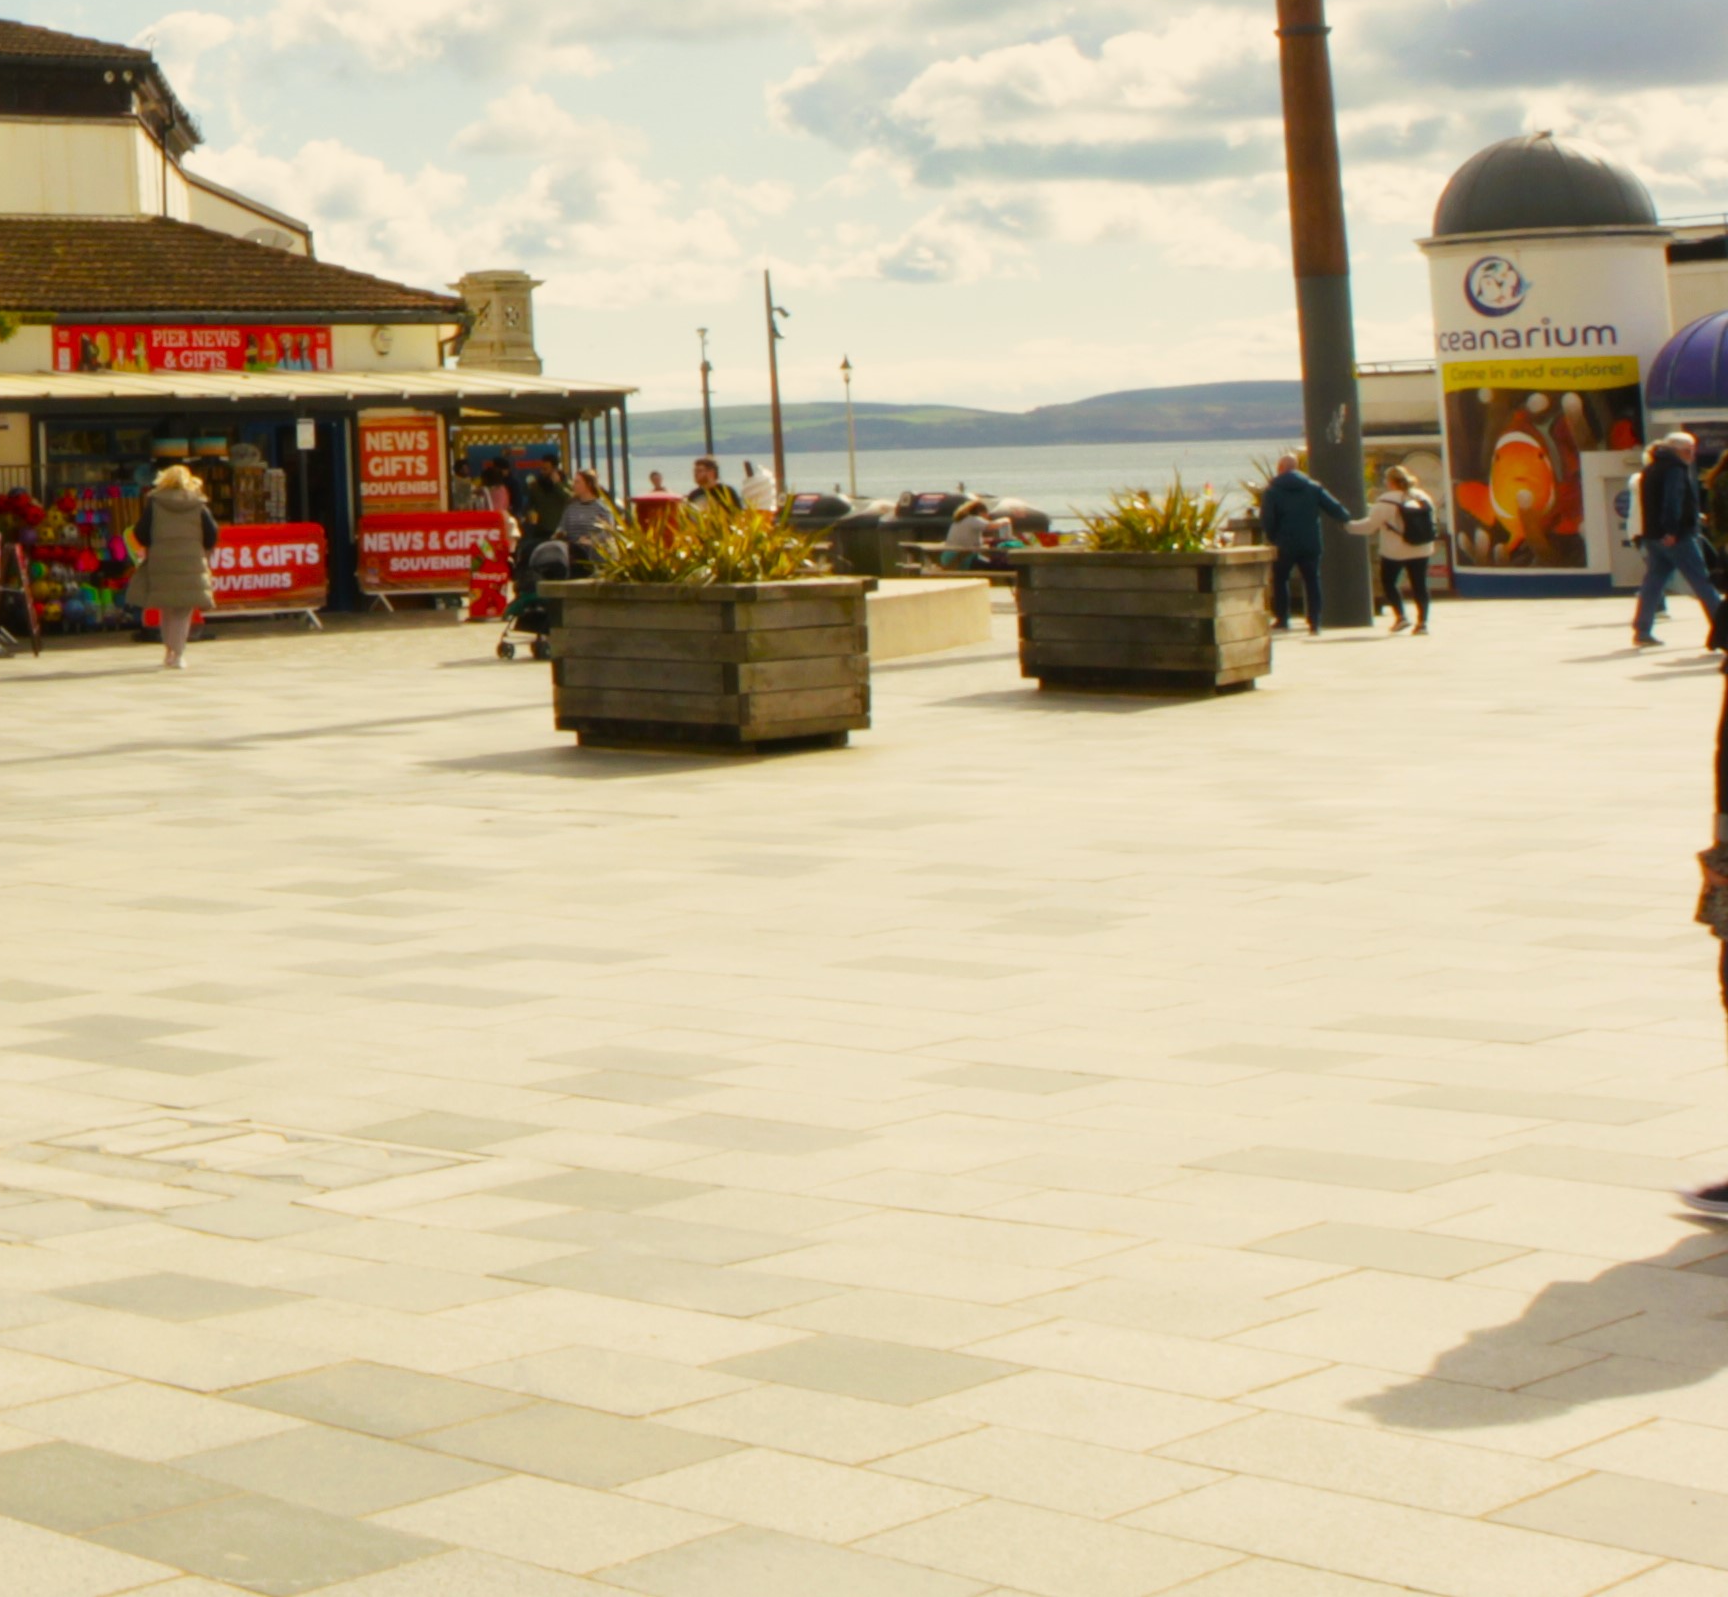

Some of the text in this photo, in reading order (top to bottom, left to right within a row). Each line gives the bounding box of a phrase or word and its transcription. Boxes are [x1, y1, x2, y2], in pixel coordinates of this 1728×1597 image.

[151, 328, 241, 348] PIER NEWS
[163, 350, 227, 369] & GIFTS
[1450, 362, 1624, 381] Come in and explore!
[365, 430, 430, 452] NEWS
[368, 455, 429, 478] GIFTS
[360, 479, 438, 497] SOUVENIRS
[363, 531, 425, 553] NEWS
[427, 530, 442, 551] &
[239, 545, 254, 568] &
[256, 542, 320, 566] GIFTS
